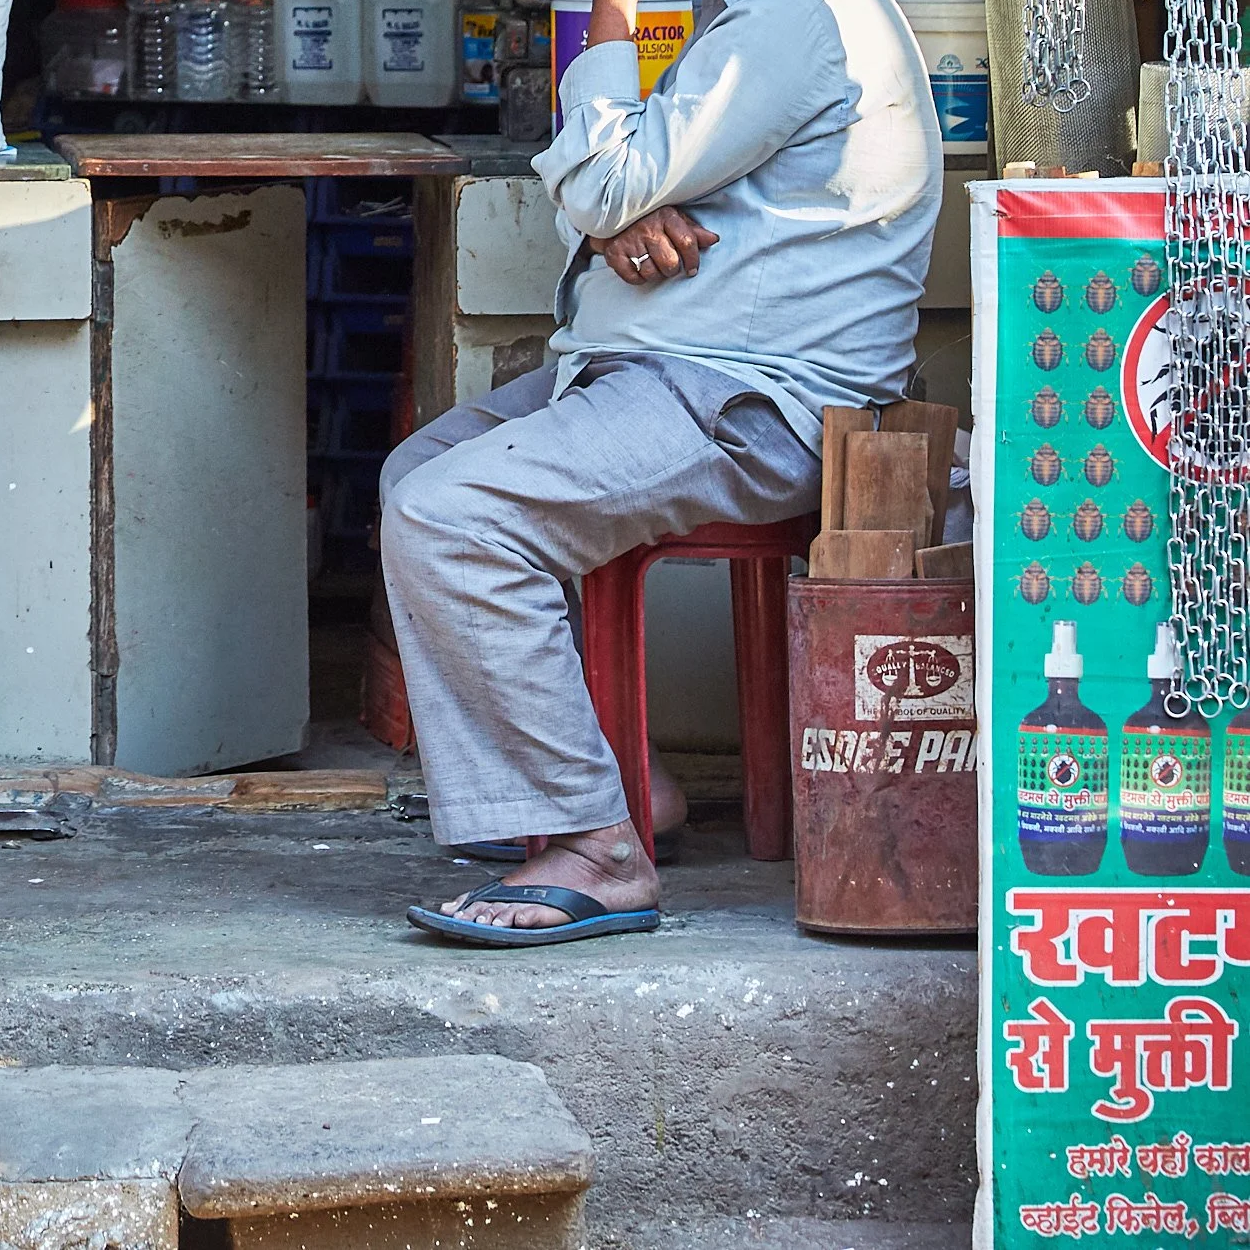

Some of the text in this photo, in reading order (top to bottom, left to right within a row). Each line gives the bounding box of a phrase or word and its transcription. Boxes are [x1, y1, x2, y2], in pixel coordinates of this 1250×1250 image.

[637, 43, 674, 53] ULSION
[917, 707, 928, 716] OF
[930, 706, 966, 716] QUALITY
[1004, 996, 1238, 1122] से मुक्ती
[1066, 1135, 1132, 1178] हमारे
[1136, 1131, 1193, 1177] यहाँ
[1020, 1192, 1100, 1239] व्हाईट
[1206, 1192, 1250, 1236] ब्लि
